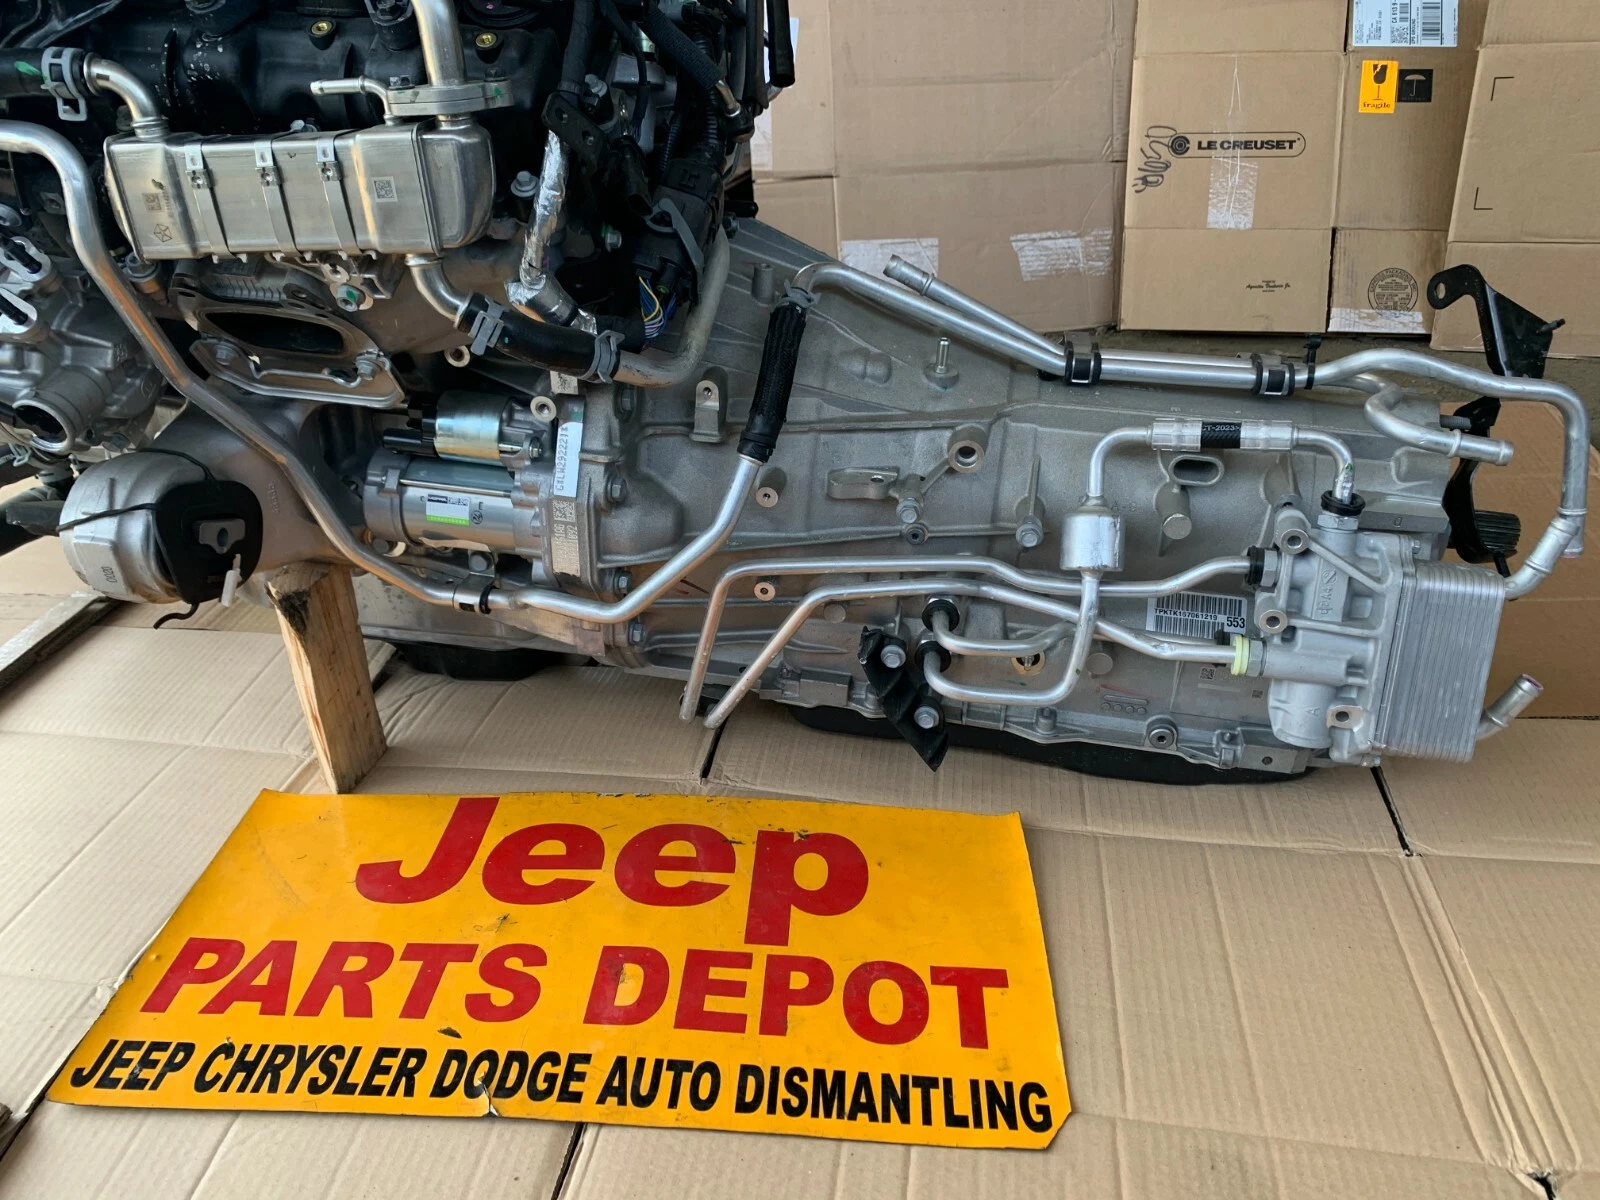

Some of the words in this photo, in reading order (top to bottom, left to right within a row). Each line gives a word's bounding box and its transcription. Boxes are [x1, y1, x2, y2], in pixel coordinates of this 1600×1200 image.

[1197, 140, 1218, 150] LE
[1219, 139, 1297, 150] CREUSET
[1226, 616, 1246, 629] 553
[356, 797, 869, 946] Jeep
[142, 937, 547, 1022] PARTS
[585, 945, 1009, 1048] DEPOT
[70, 1039, 196, 1091] JEEP
[194, 1042, 428, 1097] CHRYSLER
[430, 1049, 592, 1104] DODGE
[596, 1055, 721, 1112] AUTO
[735, 1063, 1053, 1134] DISMANTLING
